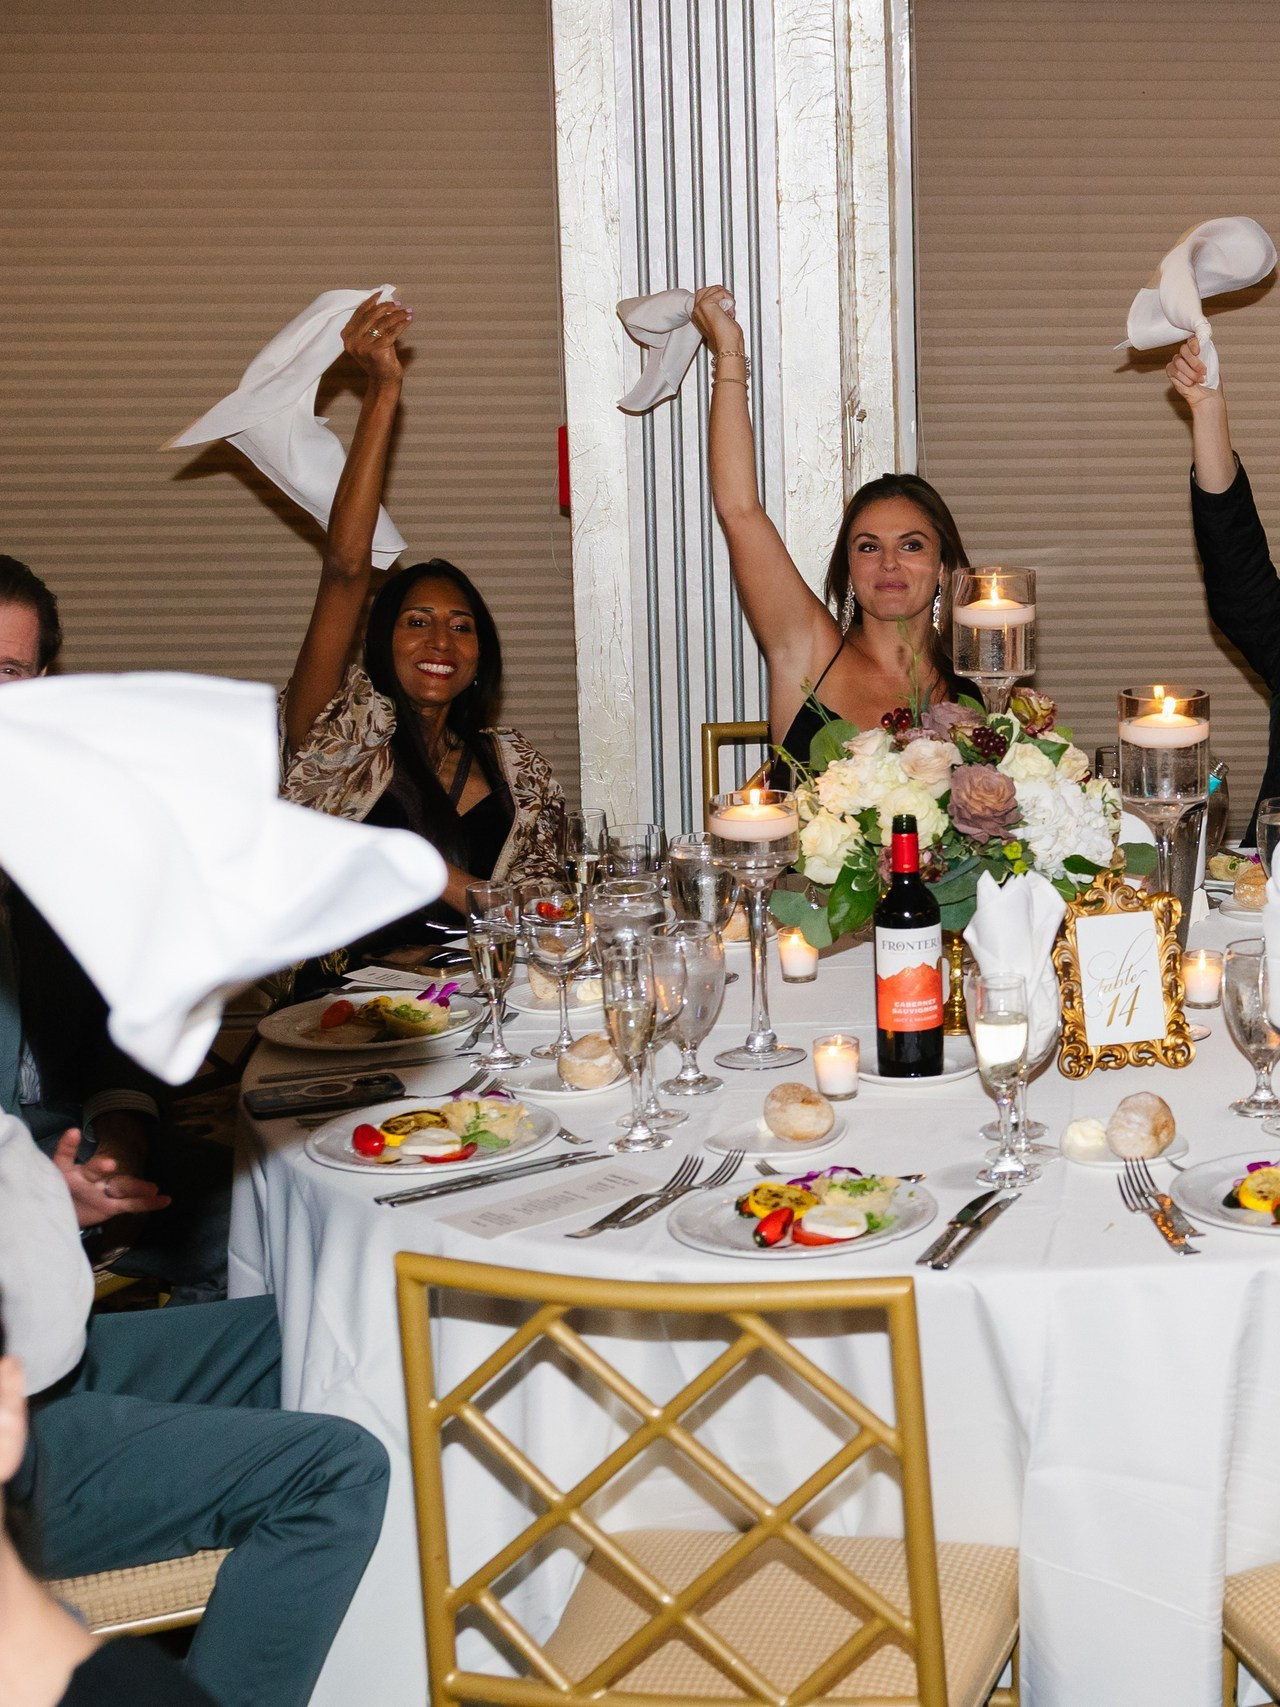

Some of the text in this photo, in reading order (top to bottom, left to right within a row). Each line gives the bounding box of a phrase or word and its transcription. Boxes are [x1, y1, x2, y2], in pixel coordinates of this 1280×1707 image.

[893, 998, 937, 1008] CABERNET
[1106, 984, 1140, 1027] 14
[892, 1005, 938, 1014] SAUVIGNON
